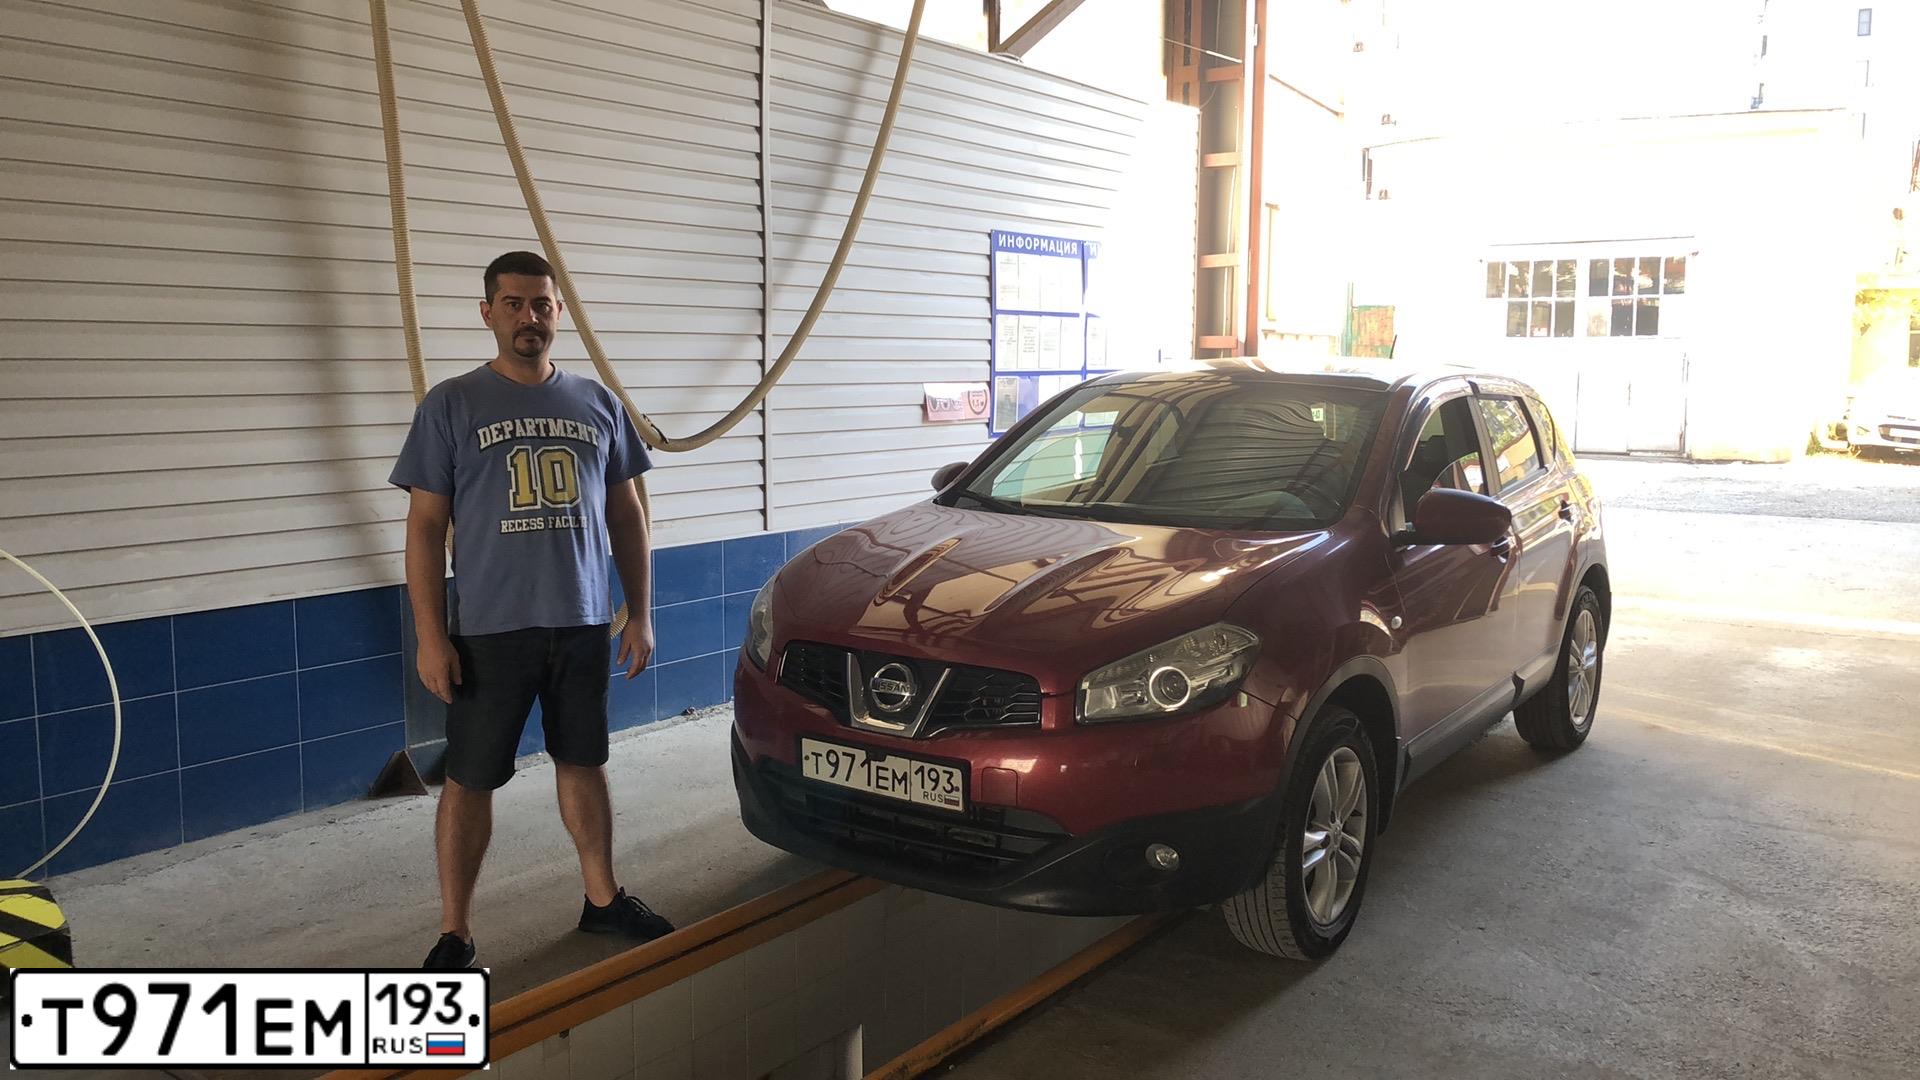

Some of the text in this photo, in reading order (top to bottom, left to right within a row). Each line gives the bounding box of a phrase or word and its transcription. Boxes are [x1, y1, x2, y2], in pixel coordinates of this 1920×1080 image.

[998, 234, 1079, 256] ИНФОРМАЦИЯ
[477, 417, 599, 450] DEPARTMENT
[506, 445, 582, 512] 10
[500, 517, 545, 534] RECESS
[873, 678, 912, 694] SSAN
[914, 765, 955, 794] 193
[922, 790, 944, 803] RUS
